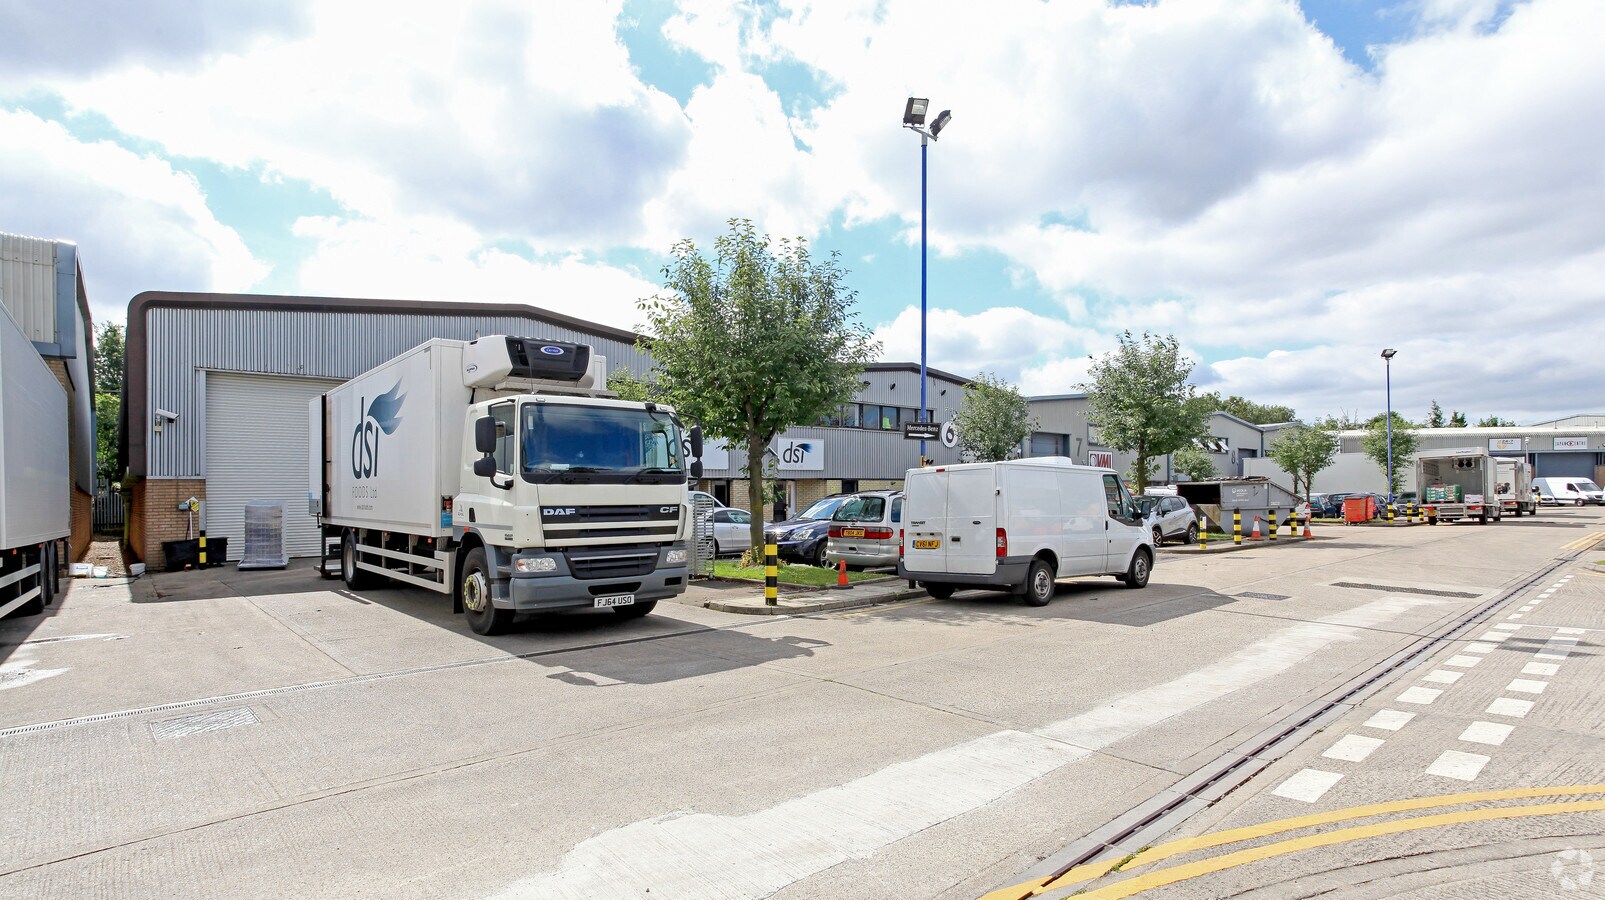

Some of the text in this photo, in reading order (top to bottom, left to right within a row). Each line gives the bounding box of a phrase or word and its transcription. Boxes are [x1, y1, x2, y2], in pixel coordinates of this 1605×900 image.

[946, 426, 955, 444] 6
[783, 441, 804, 463] dsi
[1075, 437, 1083, 457] 7
[1231, 450, 1236, 465] 8
[543, 508, 576, 516] DAF
[597, 597, 617, 606] FJ64
